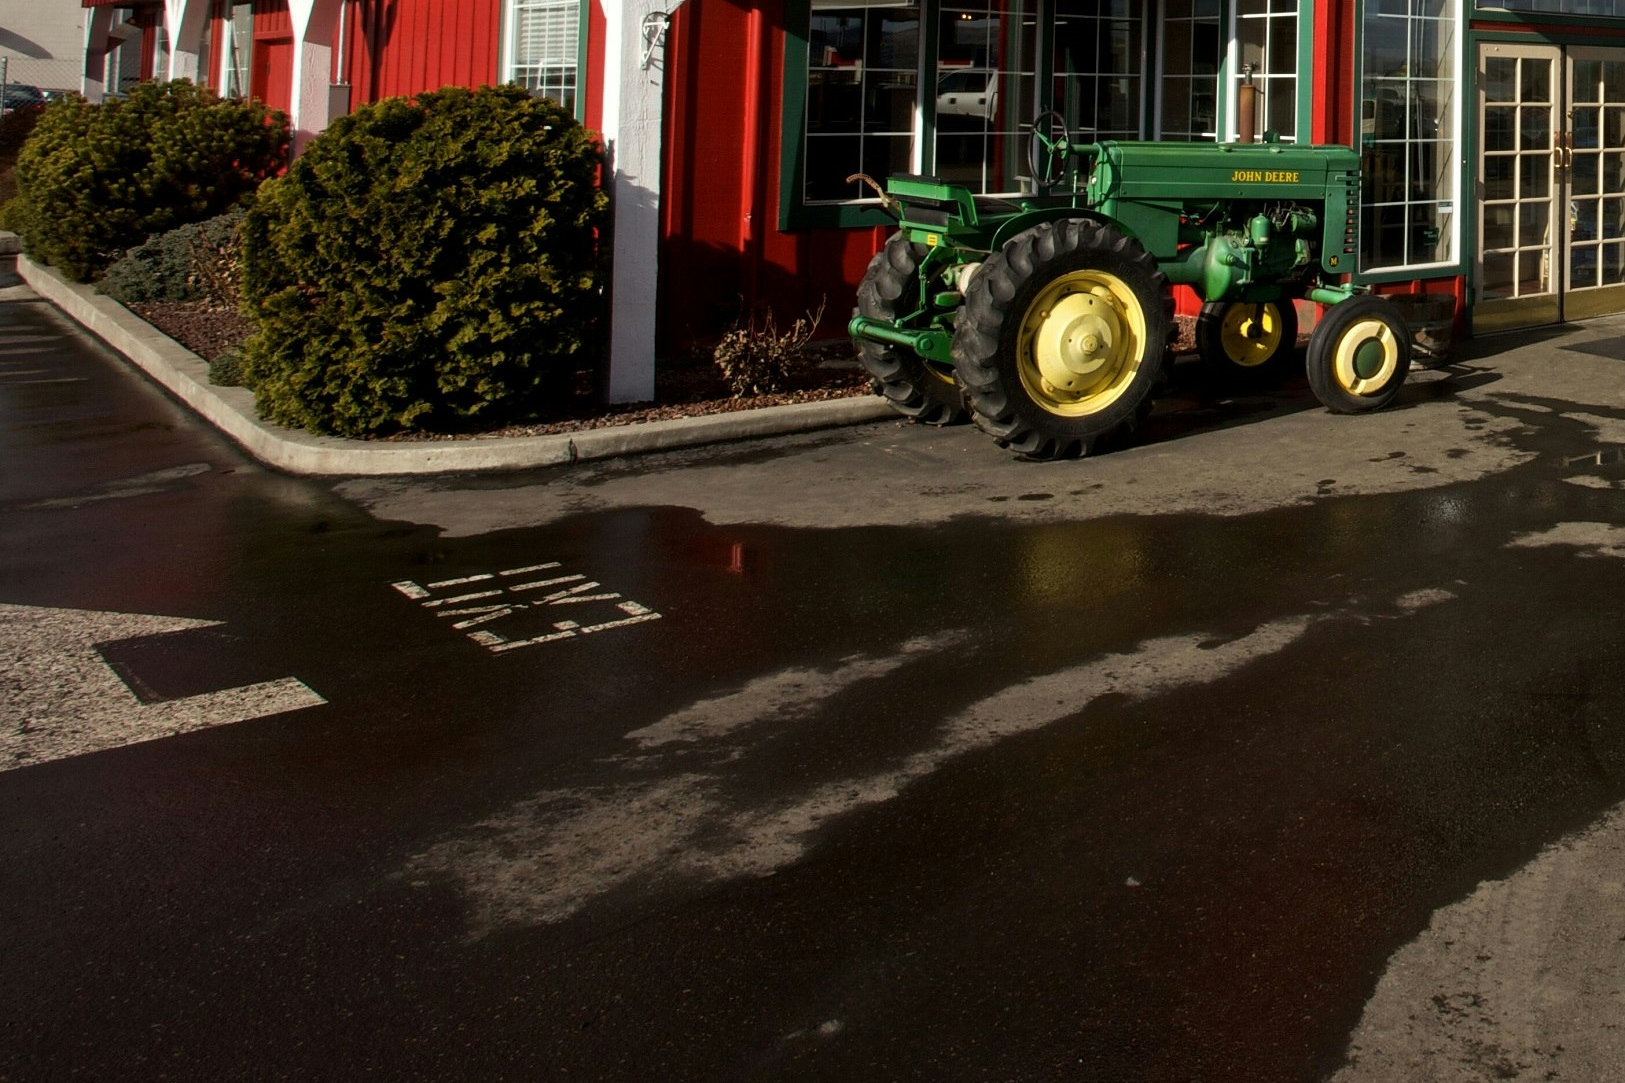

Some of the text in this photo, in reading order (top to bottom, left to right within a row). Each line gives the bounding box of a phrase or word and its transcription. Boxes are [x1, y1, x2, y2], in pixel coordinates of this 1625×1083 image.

[1232, 171, 1299, 183] JOHN DEERE
[390, 562, 662, 653] EXIT
